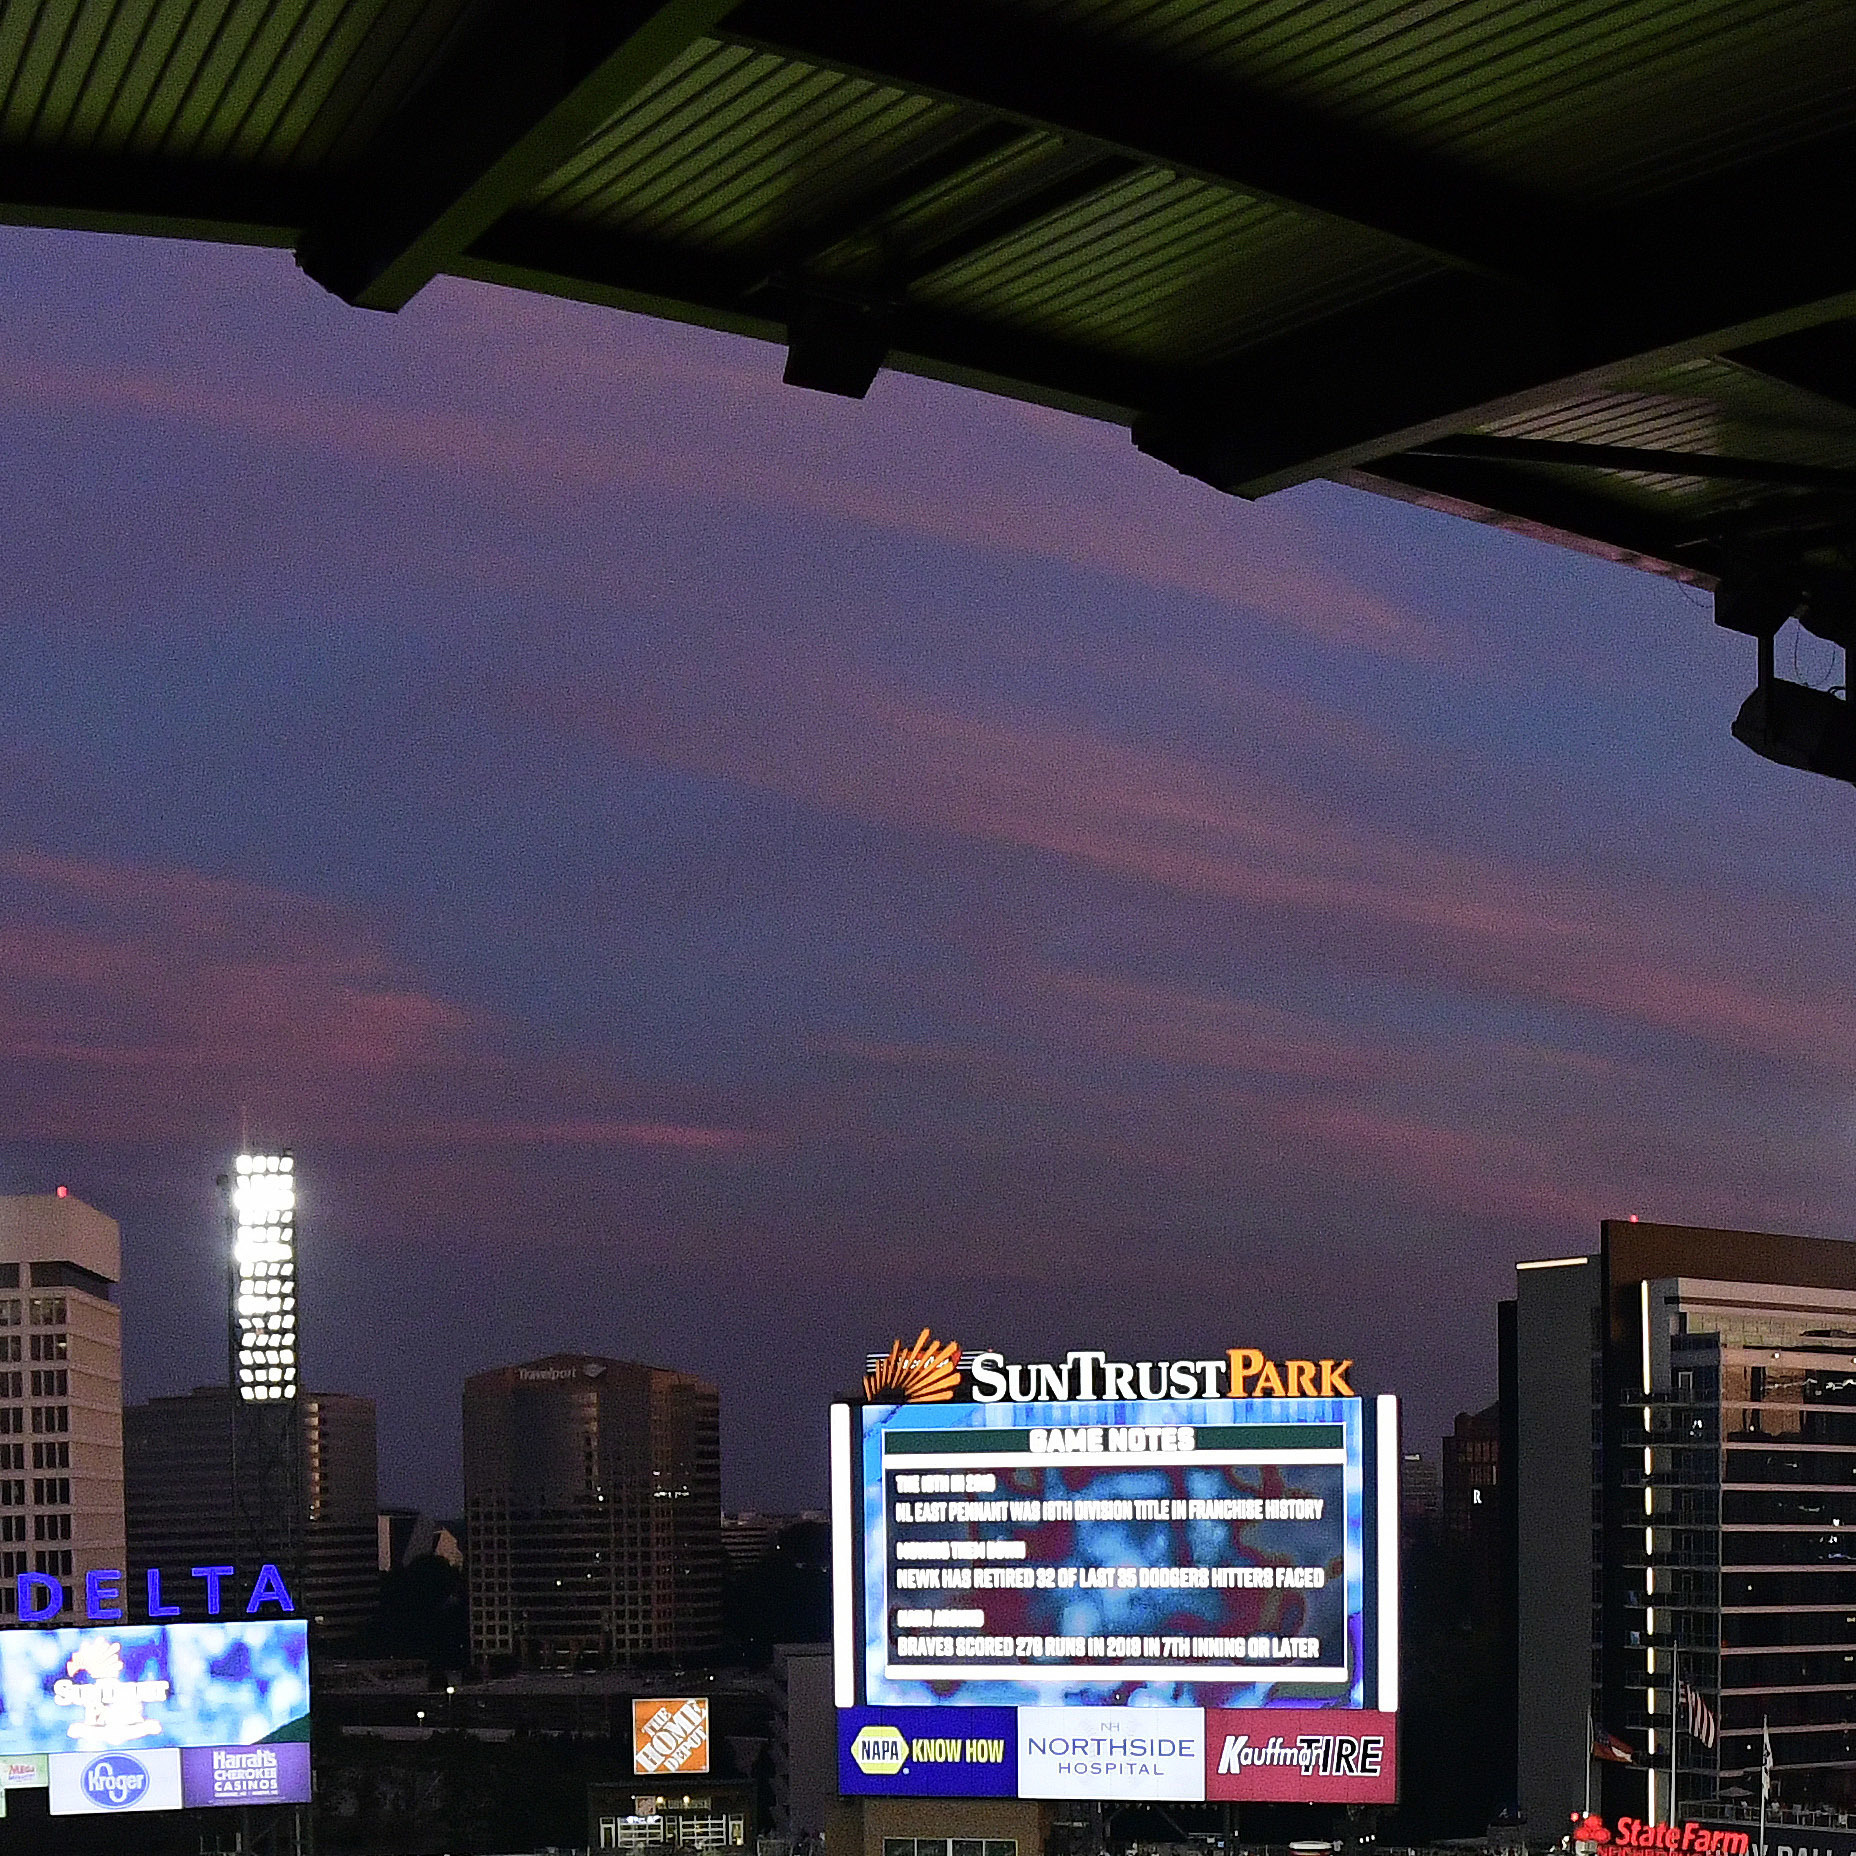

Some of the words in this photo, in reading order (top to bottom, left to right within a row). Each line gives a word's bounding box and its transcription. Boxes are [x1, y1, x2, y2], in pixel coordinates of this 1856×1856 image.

[1029, 1428, 1103, 1452] GAME
[1108, 1427, 1195, 1451] NOTES
[895, 1502, 913, 1522] NL
[914, 1502, 947, 1522] EAST
[948, 1502, 1009, 1522] PENNANT
[1010, 1501, 1041, 1521] WAS
[1074, 1500, 1132, 1521] DIVISION
[1134, 1500, 1170, 1520] TITLE
[1171, 1500, 1187, 1520] IN
[1189, 1500, 1263, 1520] FRANCHISE
[1265, 1499, 1324, 1520] HISTORY
[896, 1568, 940, 1588] NEWK
[942, 1568, 972, 1588] HAS
[973, 1568, 1034, 1588] RETIRED
[1057, 1568, 1077, 1588] OF
[1079, 1568, 1115, 1588] LAST
[1139, 1568, 1209, 1588] DODGERS
[1211, 1568, 1273, 1588] HITTERS
[1275, 1568, 1325, 1588] FACED
[17, 1564, 295, 1622] DELTA
[897, 1637, 954, 1656] BRAVES
[956, 1637, 1014, 1656] SCORED
[1045, 1637, 1086, 1656] RUNS
[1088, 1637, 1104, 1656] IN
[1145, 1637, 1160, 1657] IN
[1162, 1637, 1191, 1657] 7TH
[1193, 1637, 1245, 1657] INNING
[1247, 1637, 1271, 1657] OR
[1273, 1638, 1320, 1658] LATER
[642, 1707, 672, 1736] THE
[635, 1699, 707, 1773] HOME
[1028, 1737, 1195, 1759] NORTHSIDE
[213, 1749, 277, 1769] Harrah's
[664, 1725, 707, 1772] DEPOT
[861, 1740, 899, 1761] NAPA
[912, 1739, 962, 1763] KNOW
[965, 1738, 1004, 1762] HOW
[1297, 1735, 1383, 1777] TIRE
[214, 1767, 277, 1781] CHEROKEE
[1058, 1762, 1164, 1776] HOSPITAL
[87, 1762, 144, 1803] Kroger
[214, 1780, 278, 1791] CASINOS
